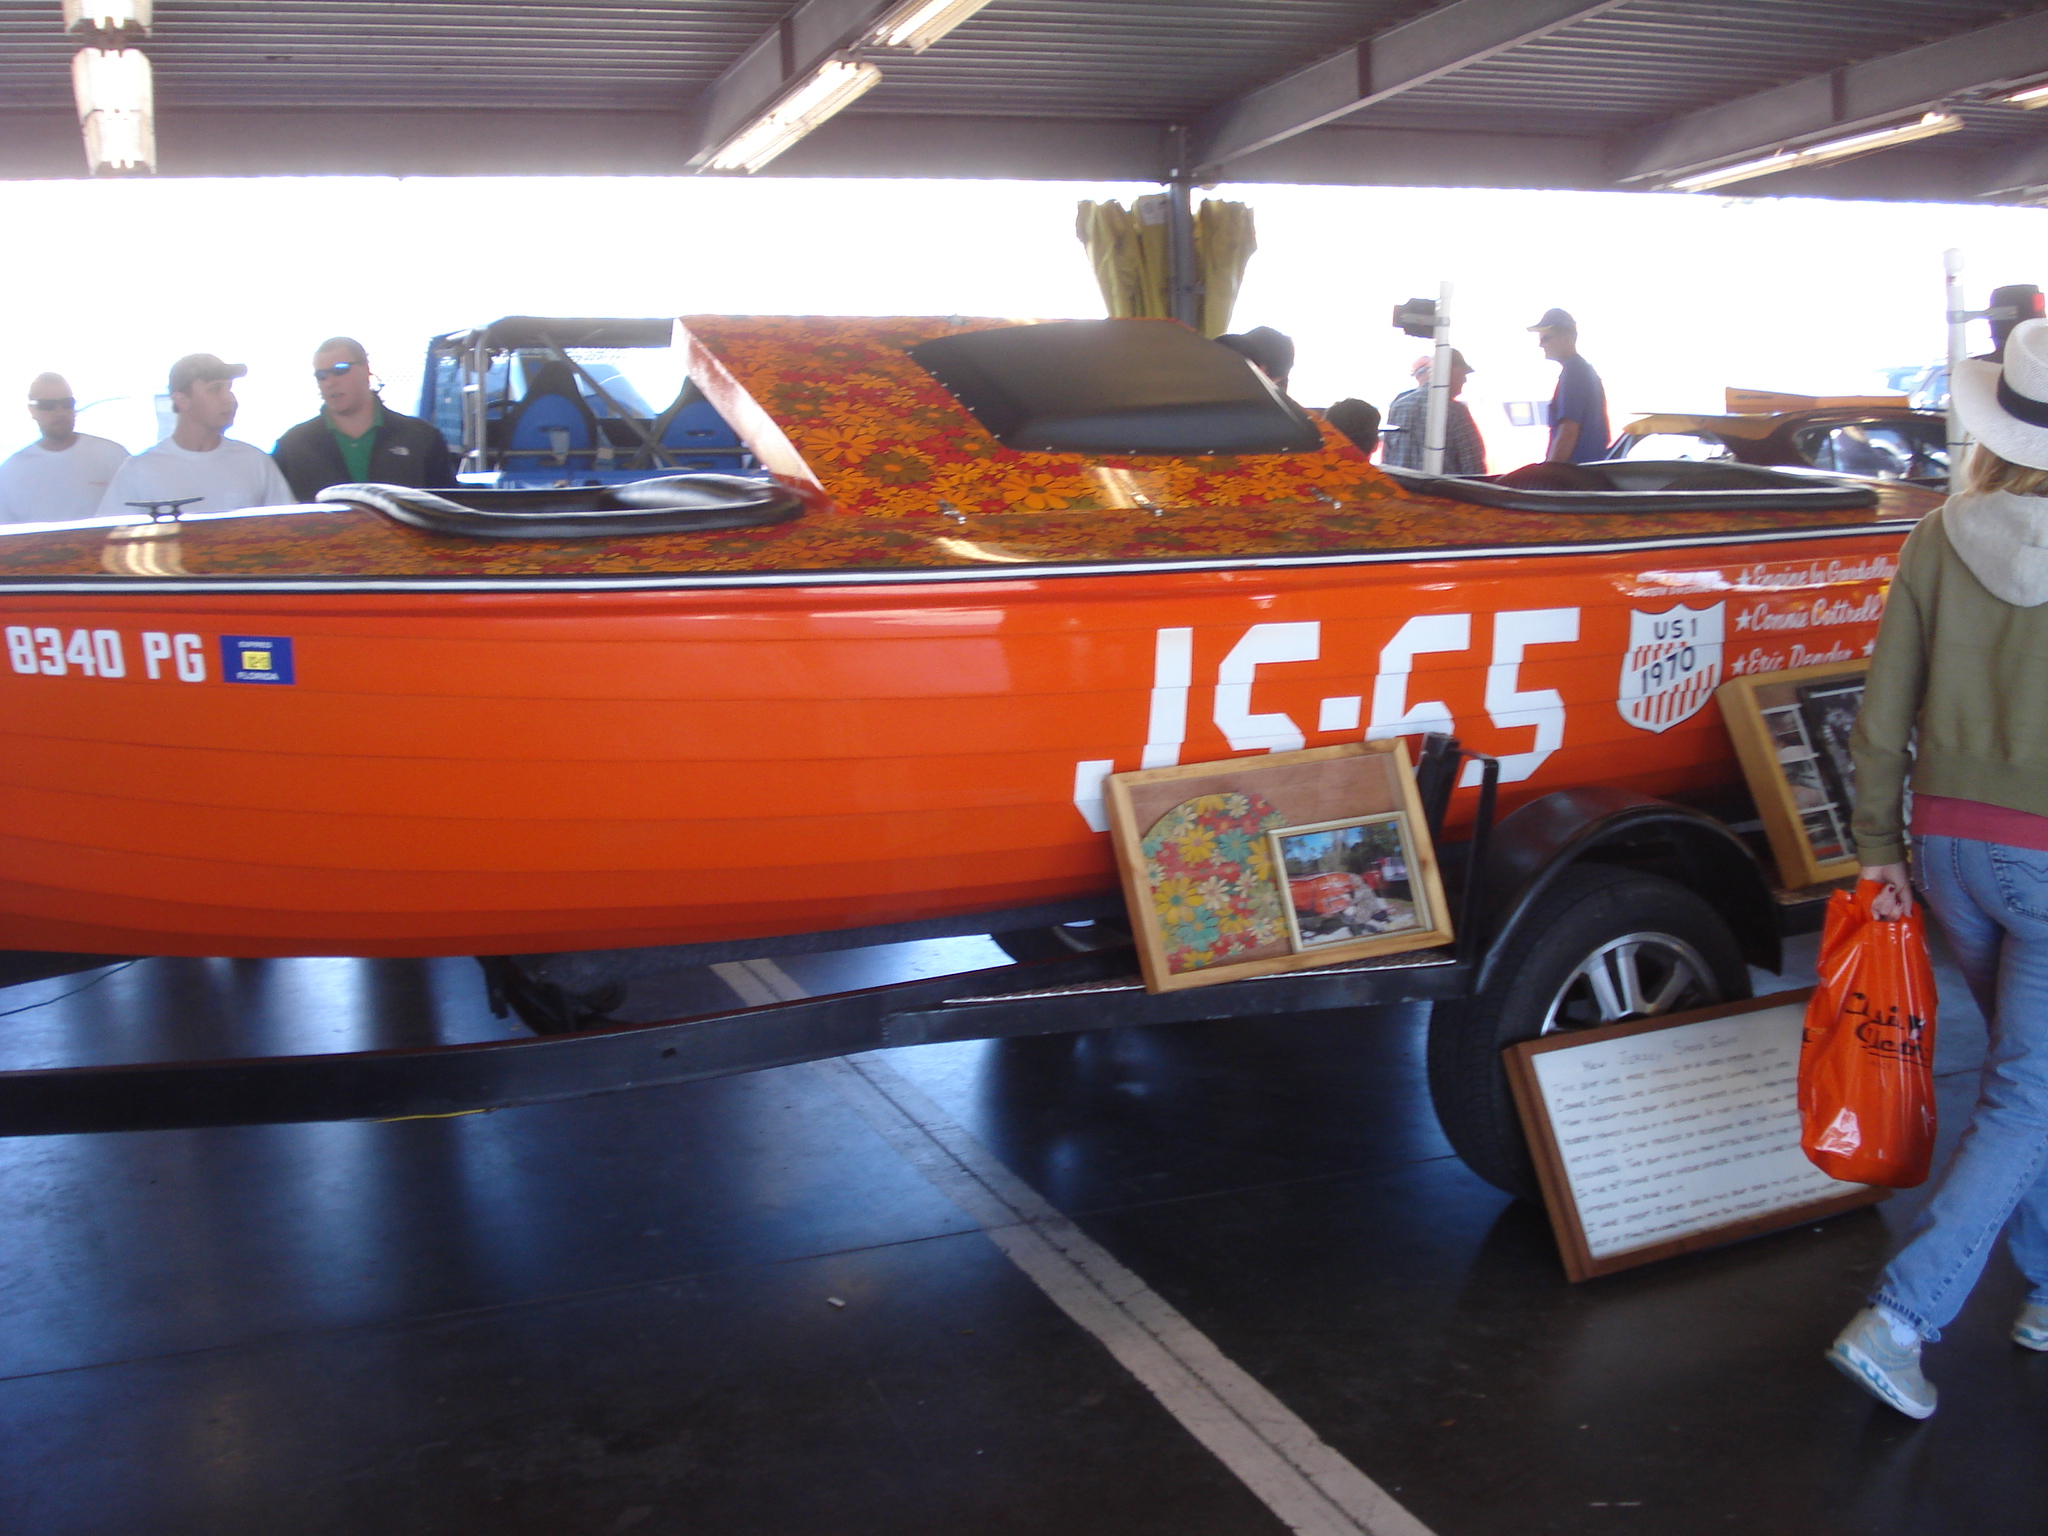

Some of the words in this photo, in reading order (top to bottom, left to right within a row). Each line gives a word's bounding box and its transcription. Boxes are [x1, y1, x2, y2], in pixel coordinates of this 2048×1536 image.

[5, 625, 126, 678] 8340
[142, 631, 207, 682] PG
[1654, 618, 1683, 640] US
[1641, 645, 1697, 695] 1970
